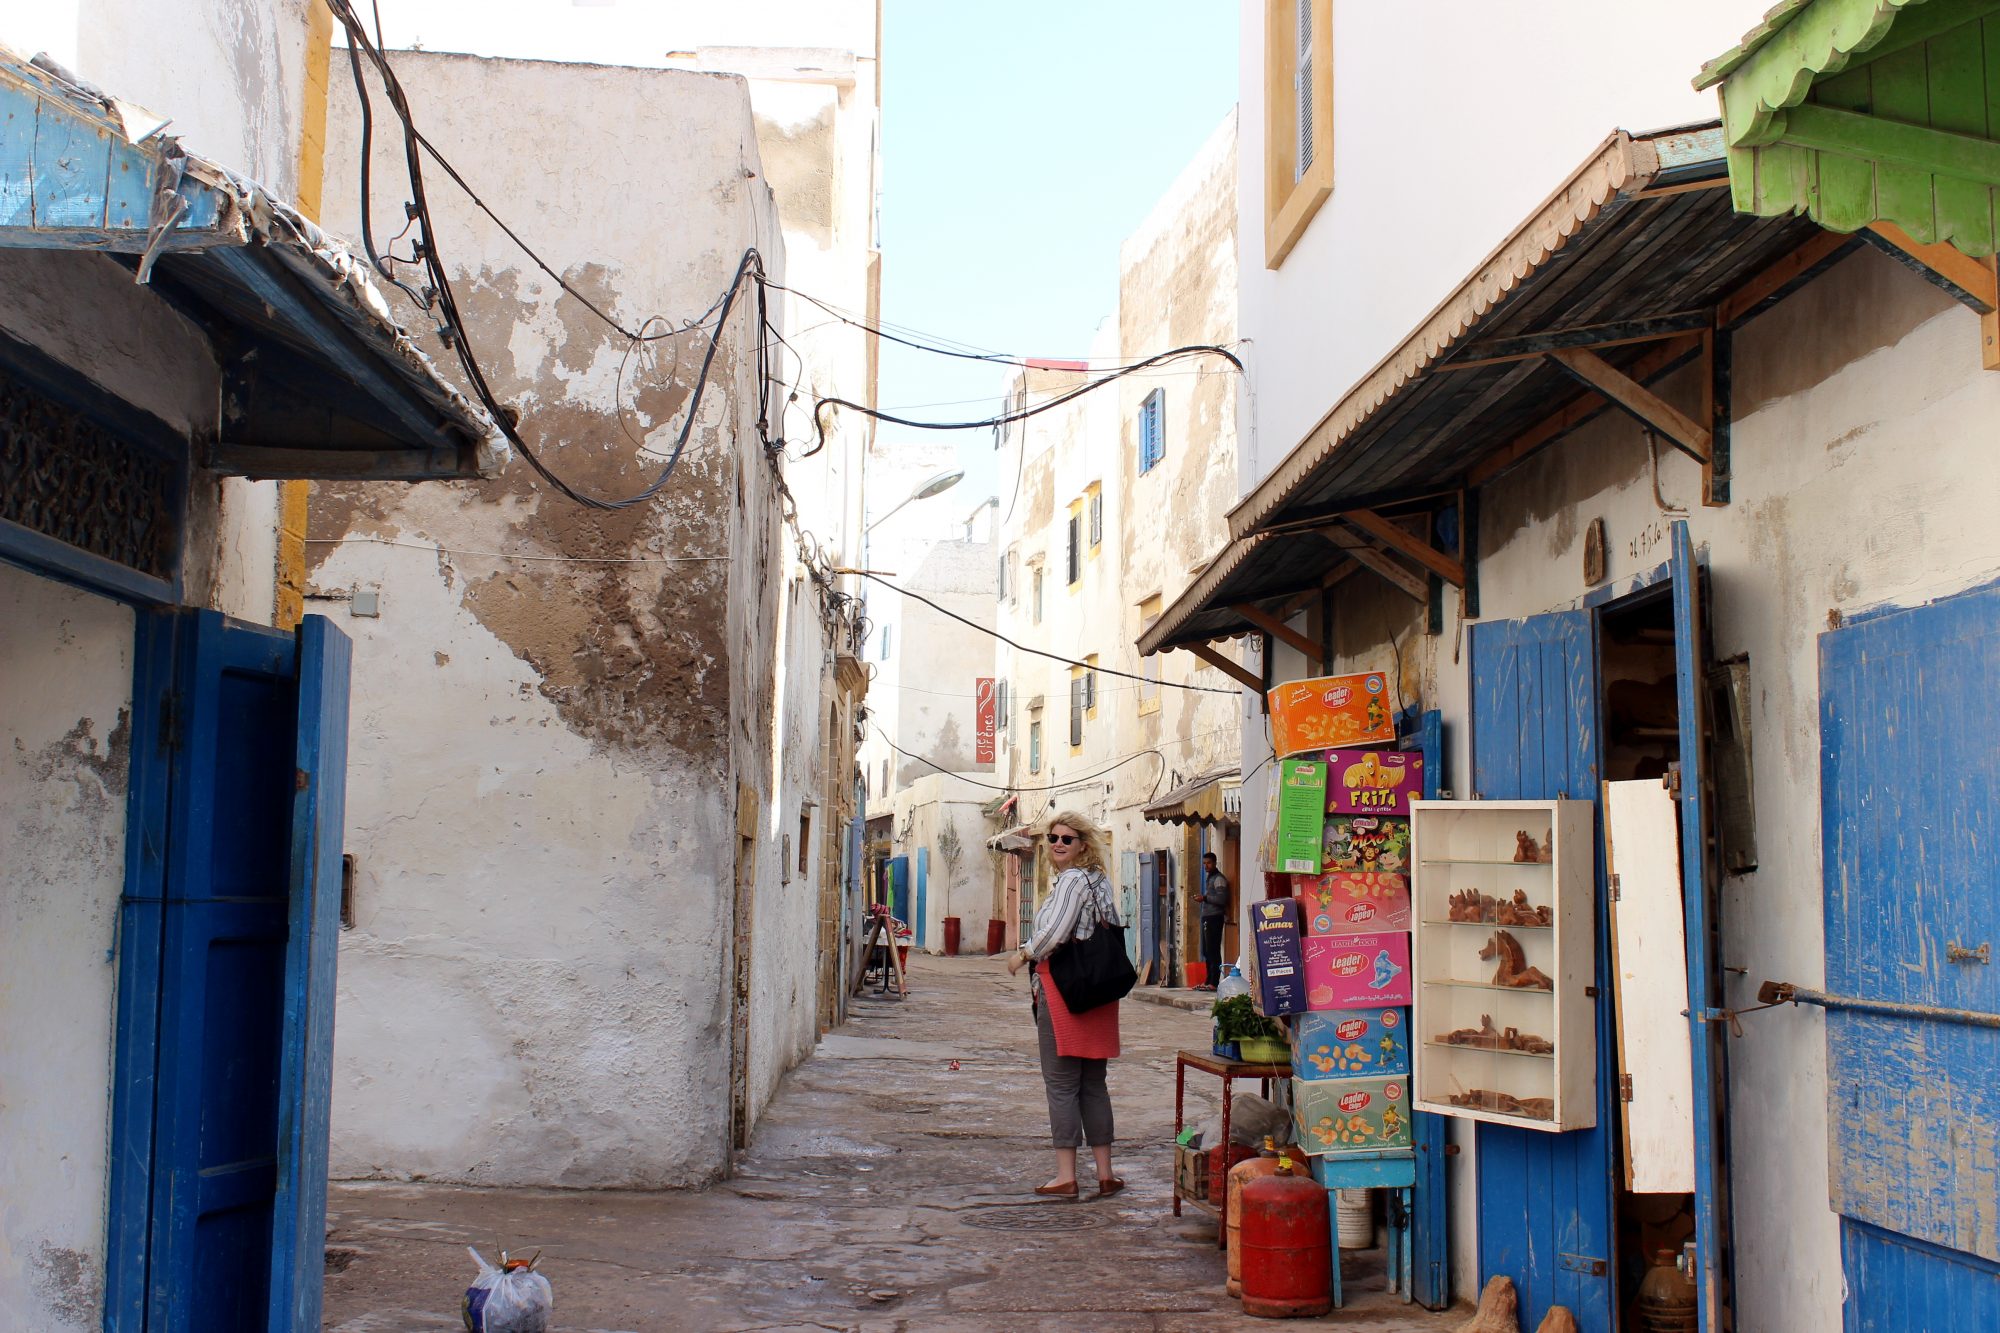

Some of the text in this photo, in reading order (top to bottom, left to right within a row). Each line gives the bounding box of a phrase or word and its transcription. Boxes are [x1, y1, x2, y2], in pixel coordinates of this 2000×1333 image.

[1325, 687, 1348, 702] Leader
[1350, 909, 1374, 922] Leader
[1257, 920, 1294, 933] Manar
[1332, 954, 1362, 969] Leader
[1341, 966, 1358, 976] Chips
[1338, 1020, 1361, 1034] Leader
[1341, 1092, 1364, 1106] Leader
